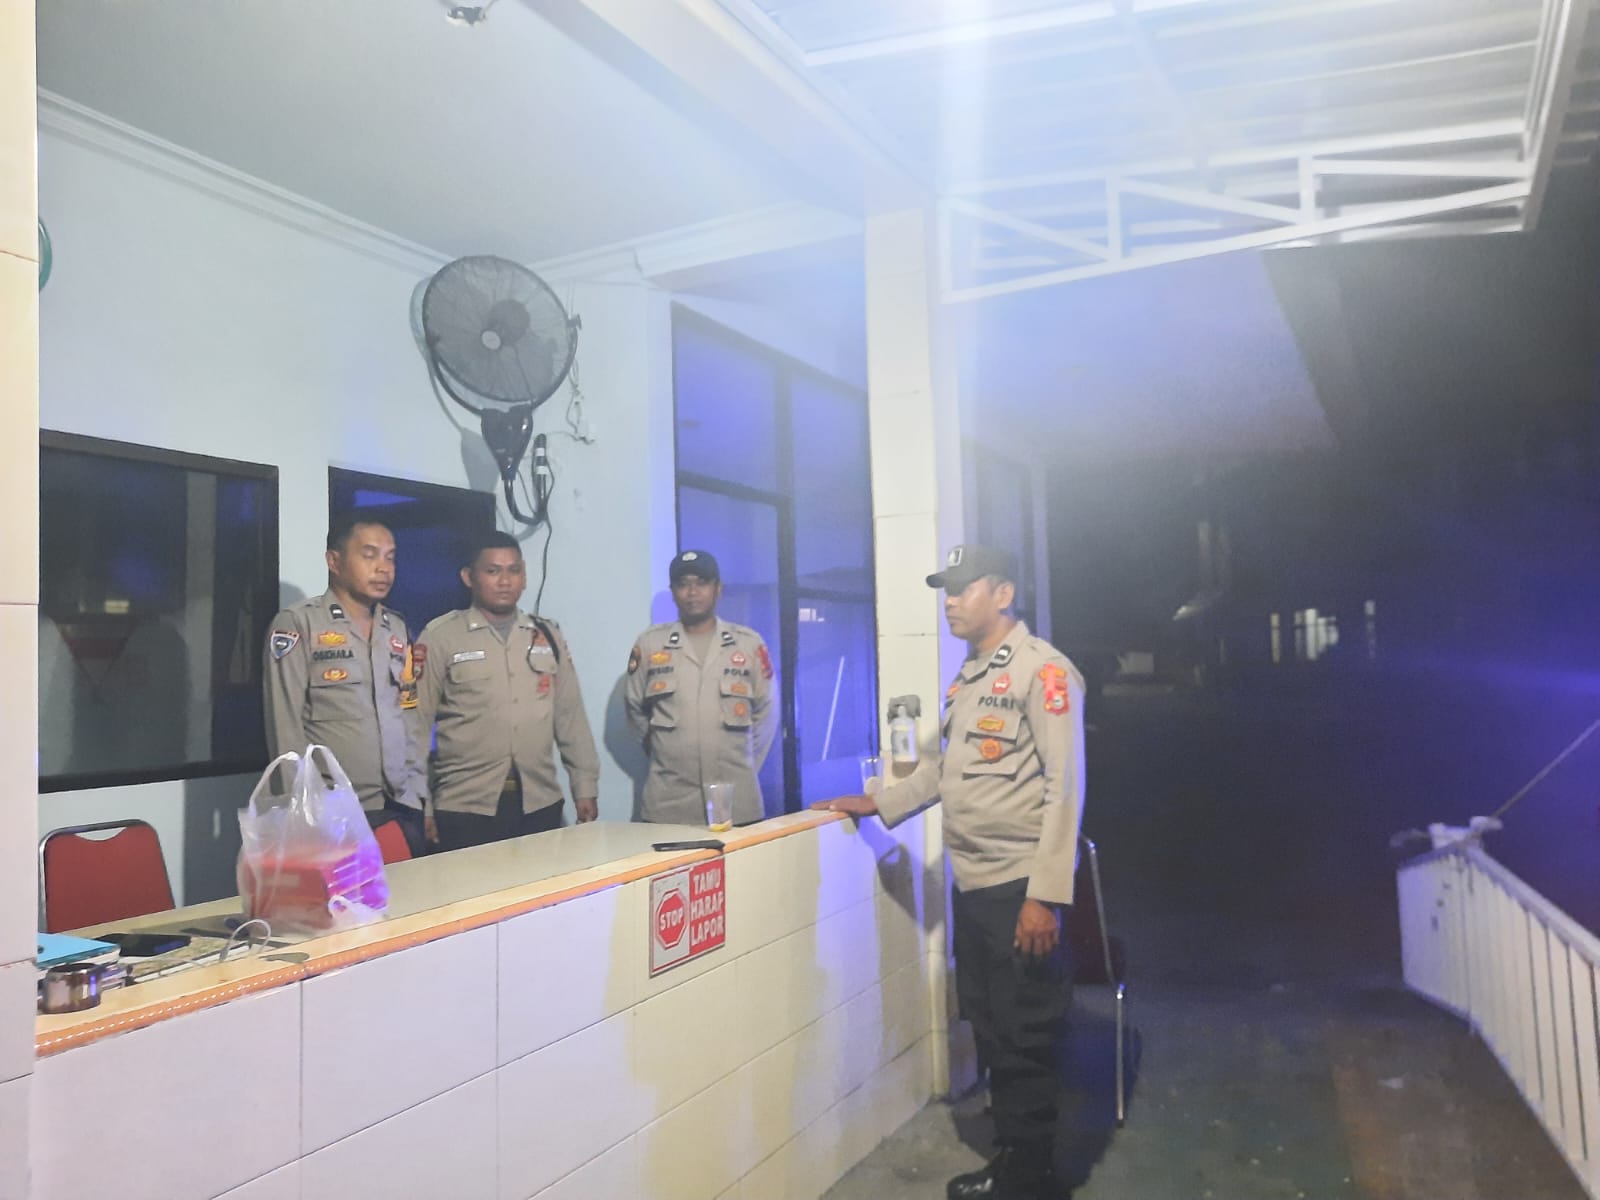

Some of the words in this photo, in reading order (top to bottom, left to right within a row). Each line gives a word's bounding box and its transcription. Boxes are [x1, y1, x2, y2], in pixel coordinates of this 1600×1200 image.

[978, 696, 1014, 710] POLRI
[693, 868, 721, 895] TAMU
[660, 907, 683, 930] STOP
[690, 891, 723, 920] HARAP
[690, 915, 723, 946] LAPOR
